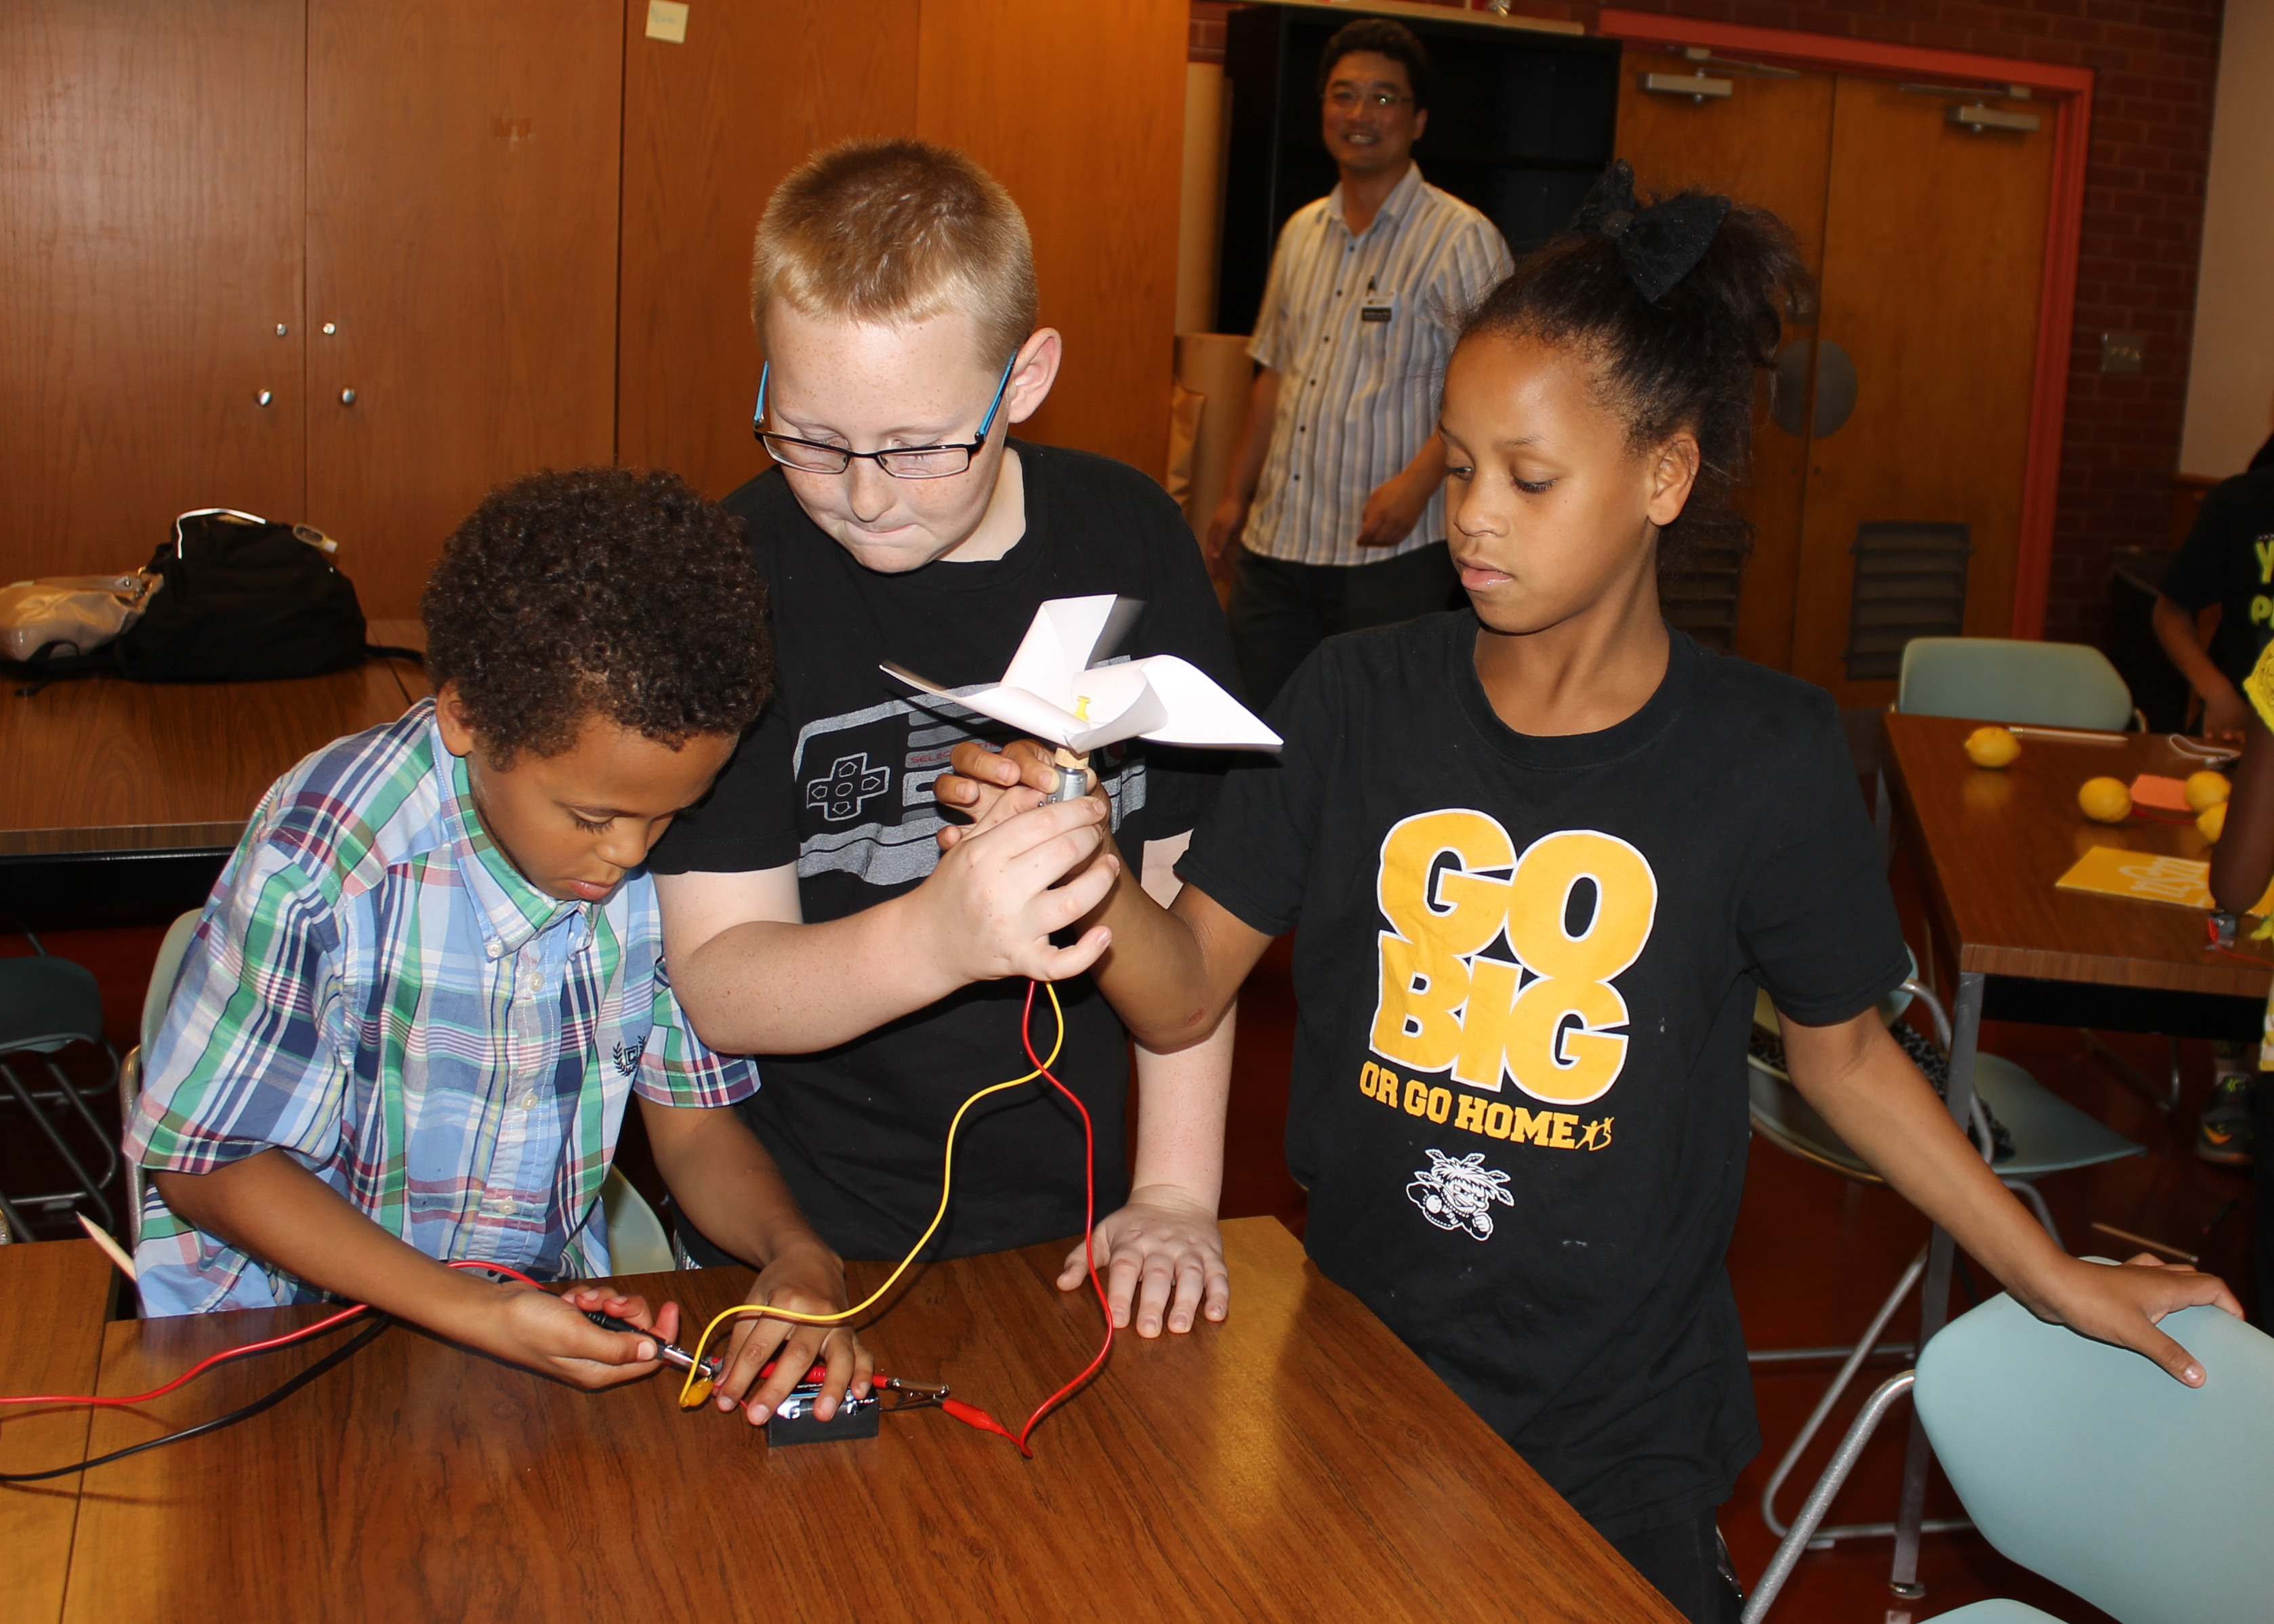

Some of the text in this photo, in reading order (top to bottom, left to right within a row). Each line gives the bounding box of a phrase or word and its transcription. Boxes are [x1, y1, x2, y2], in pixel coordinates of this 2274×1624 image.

[911, 750, 951, 764] SELEC
[1378, 808, 1657, 982] GO
[1369, 930, 1630, 1104] BIG
[1360, 1061, 1579, 1149] OR GO HOME
